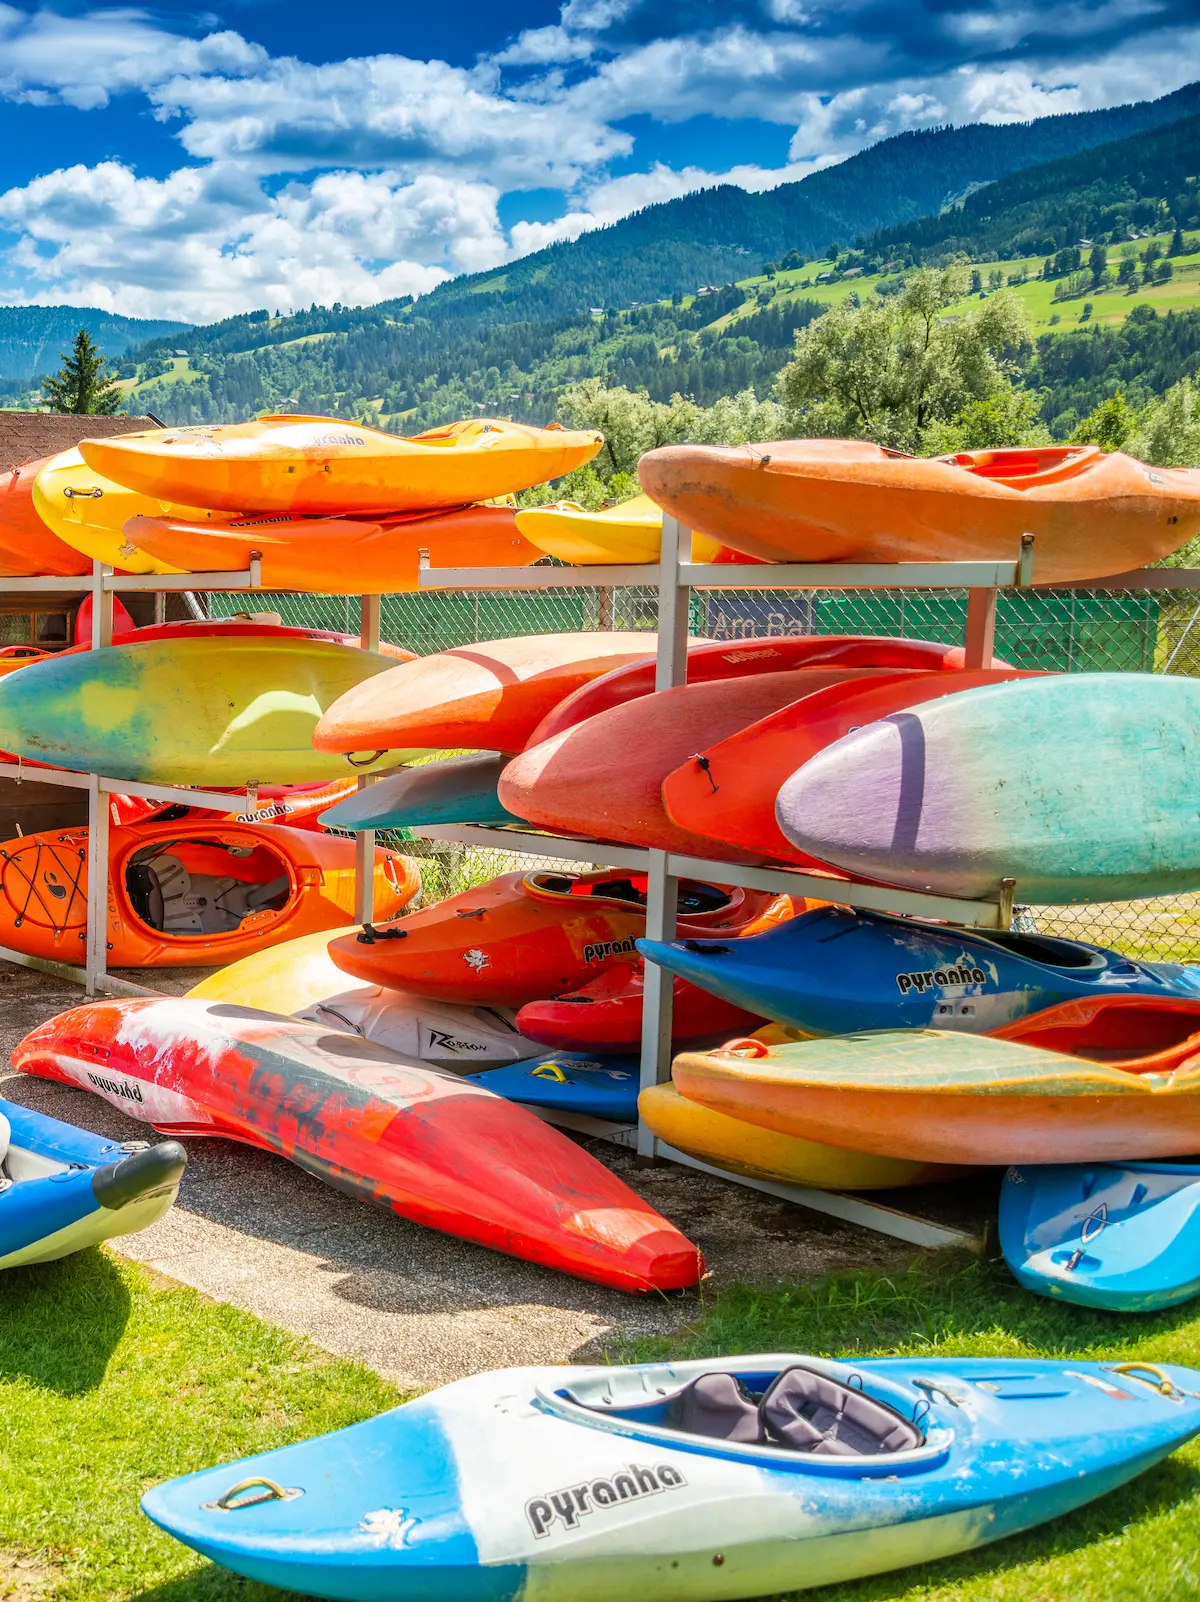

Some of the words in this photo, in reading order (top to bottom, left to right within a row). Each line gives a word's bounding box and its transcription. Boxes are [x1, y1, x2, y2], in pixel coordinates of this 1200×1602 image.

[584, 934, 638, 963] pyran
[896, 964, 986, 994] pyranha
[86, 1071, 144, 1103] pyranha
[527, 1463, 685, 1537] pyranha
